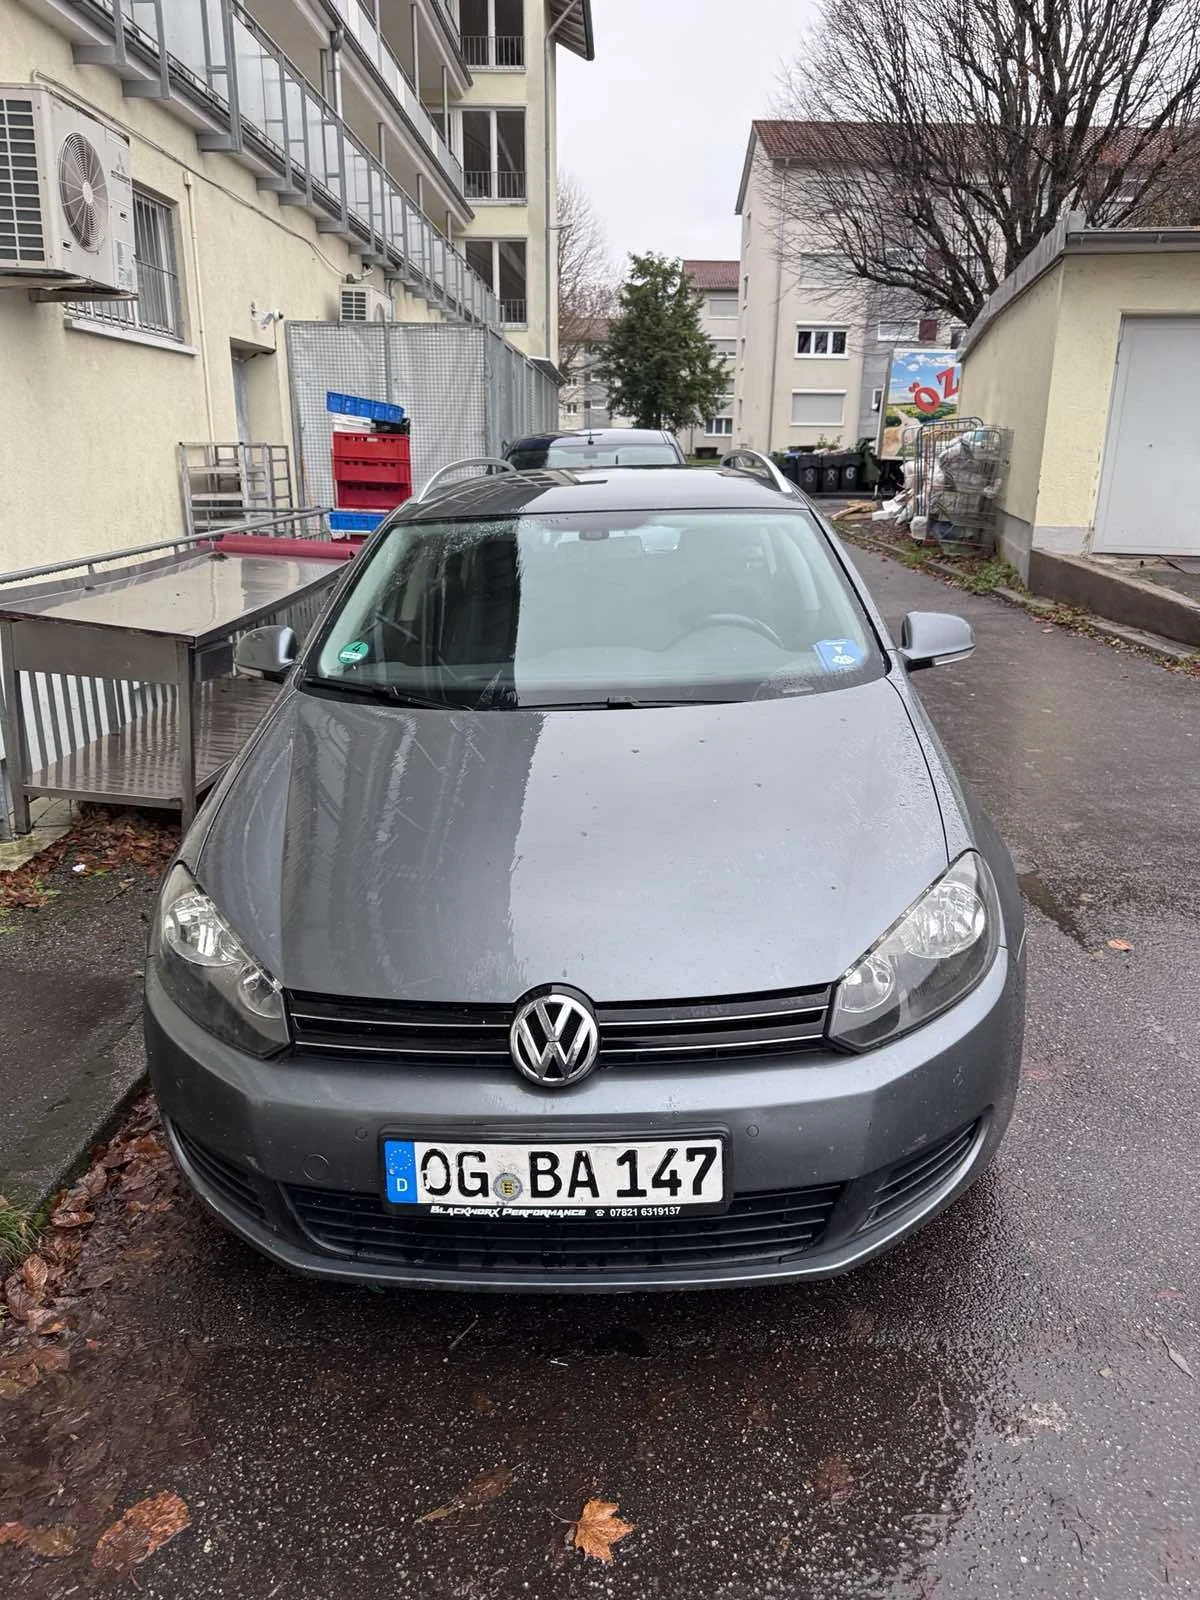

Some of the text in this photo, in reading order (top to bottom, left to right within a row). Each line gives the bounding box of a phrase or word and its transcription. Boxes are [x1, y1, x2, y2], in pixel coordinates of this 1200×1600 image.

[420, 1148, 490, 1198] OG
[528, 1151, 600, 1198] BA
[616, 1147, 718, 1197] 147
[396, 1178, 408, 1192] D
[609, 1208, 638, 1217] 07821
[640, 1206, 681, 1216] 6319137
